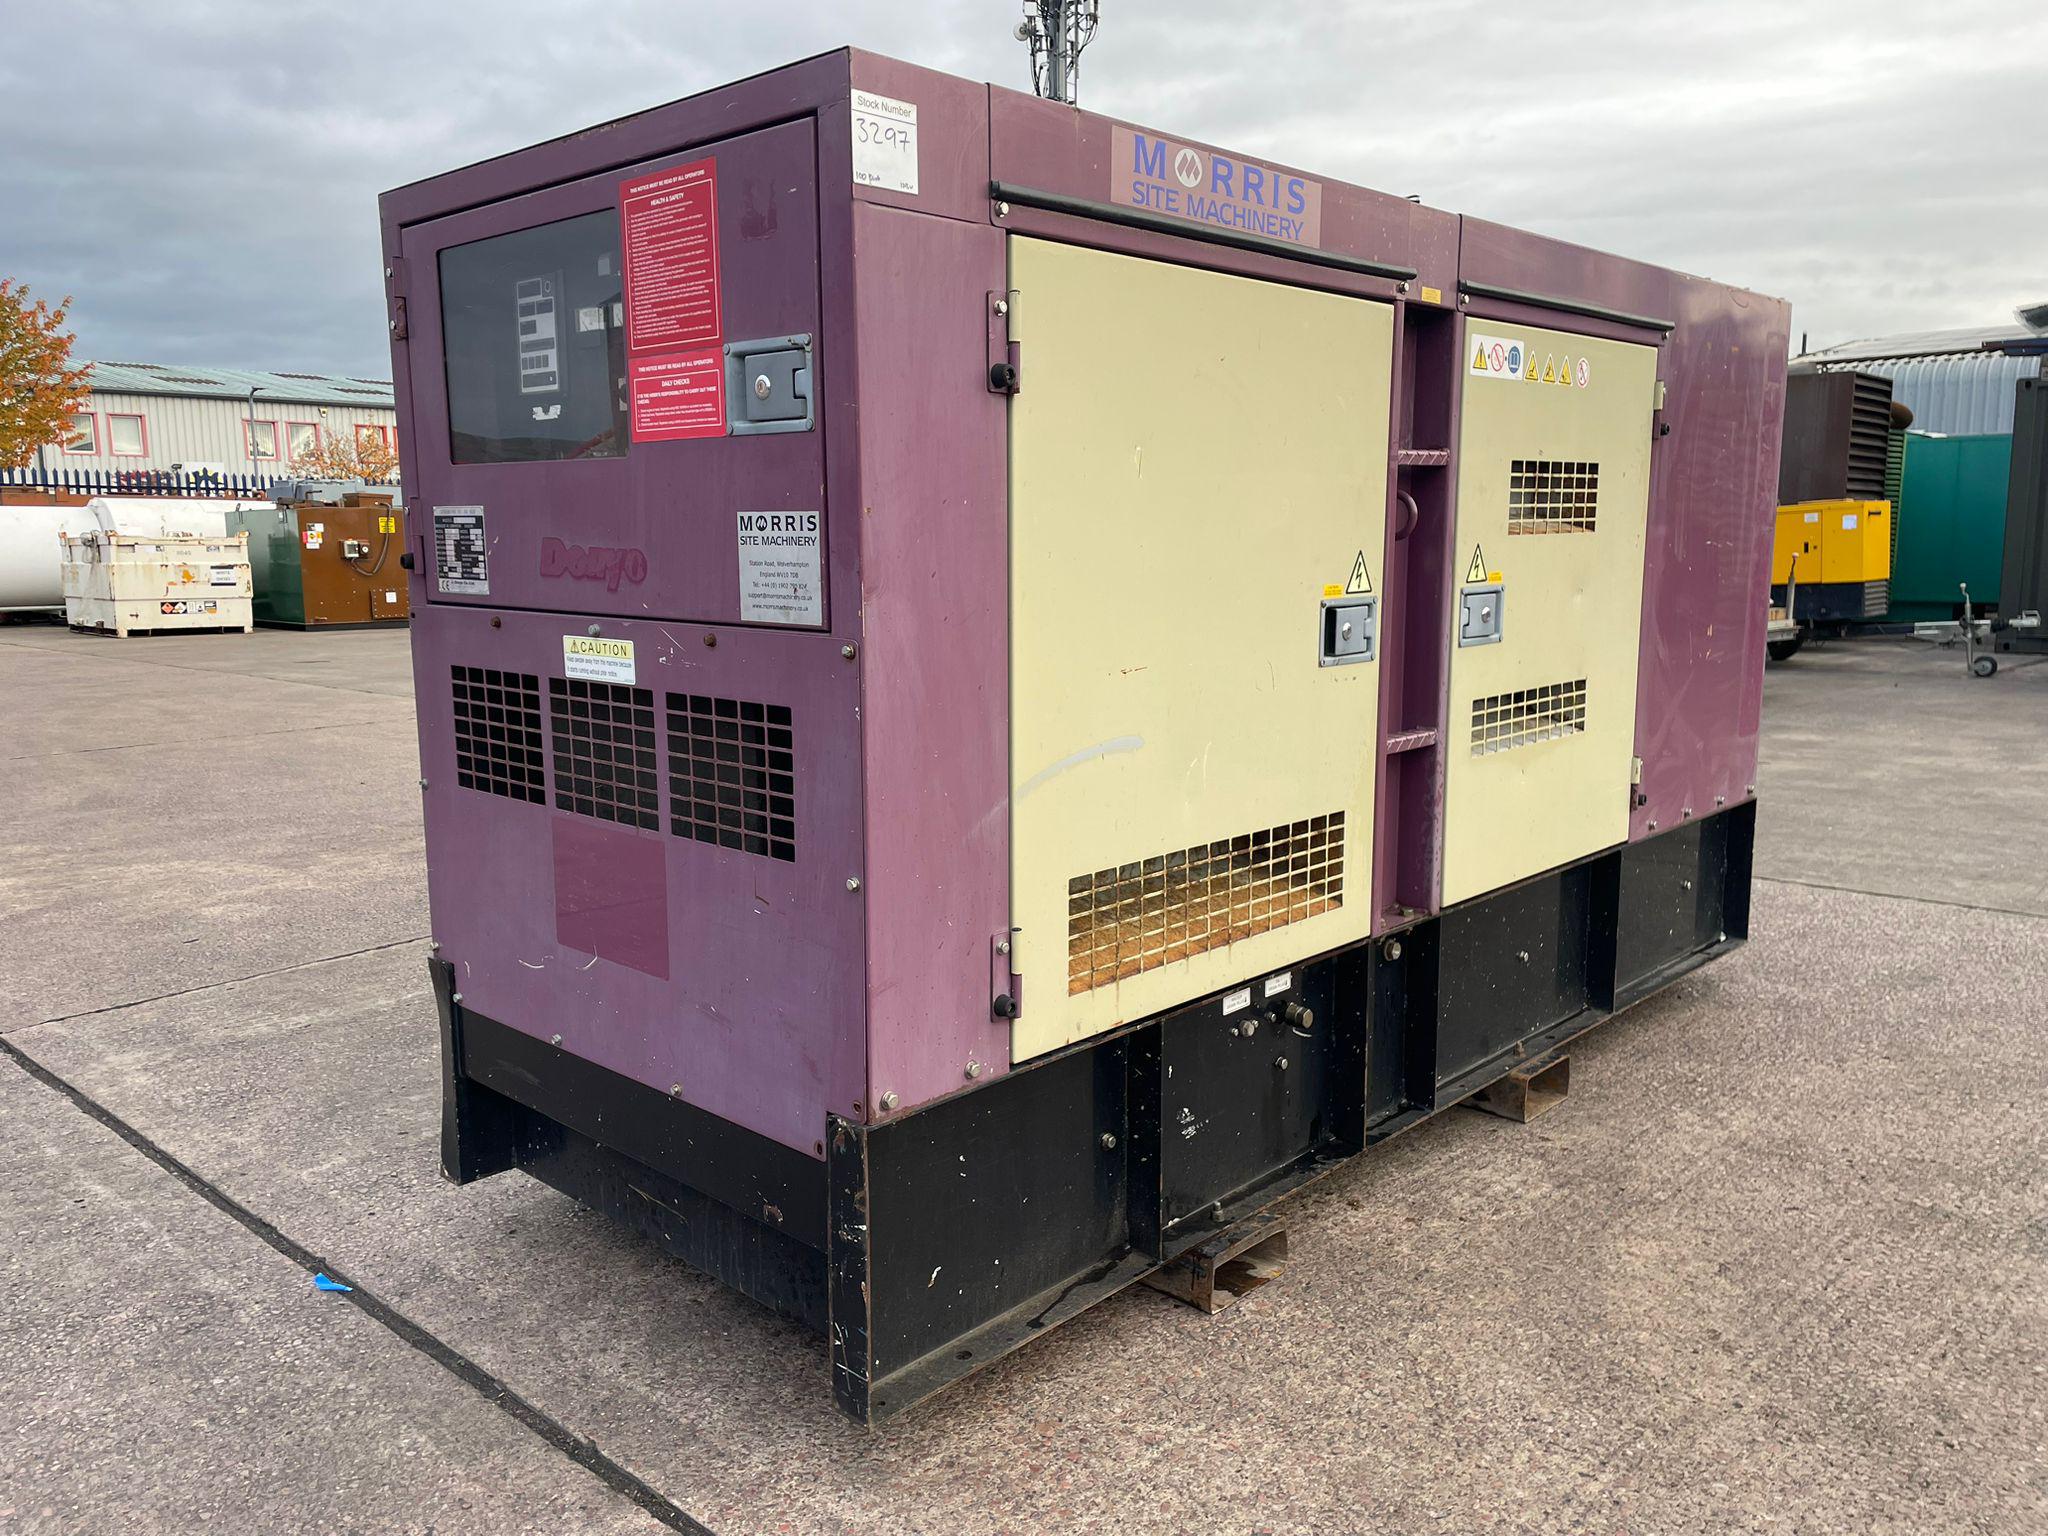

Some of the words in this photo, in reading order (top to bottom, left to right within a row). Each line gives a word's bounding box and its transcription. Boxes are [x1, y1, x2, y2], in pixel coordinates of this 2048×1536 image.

[857, 95, 879, 110] Stock
[881, 102, 911, 118] Number
[856, 118, 911, 152] 3297
[1133, 134, 1305, 215] MORRIS
[650, 196, 666, 206] HEALTH
[669, 191, 684, 202] SAFETY
[1132, 180, 1179, 213] SITE
[1186, 194, 1304, 240] MACHINERY
[673, 378, 690, 386] CHECKS
[739, 515, 817, 531] MORRIS
[740, 535, 759, 546] SITE
[761, 536, 817, 547] MACHINERY
[580, 641, 627, 656] CAUTION
